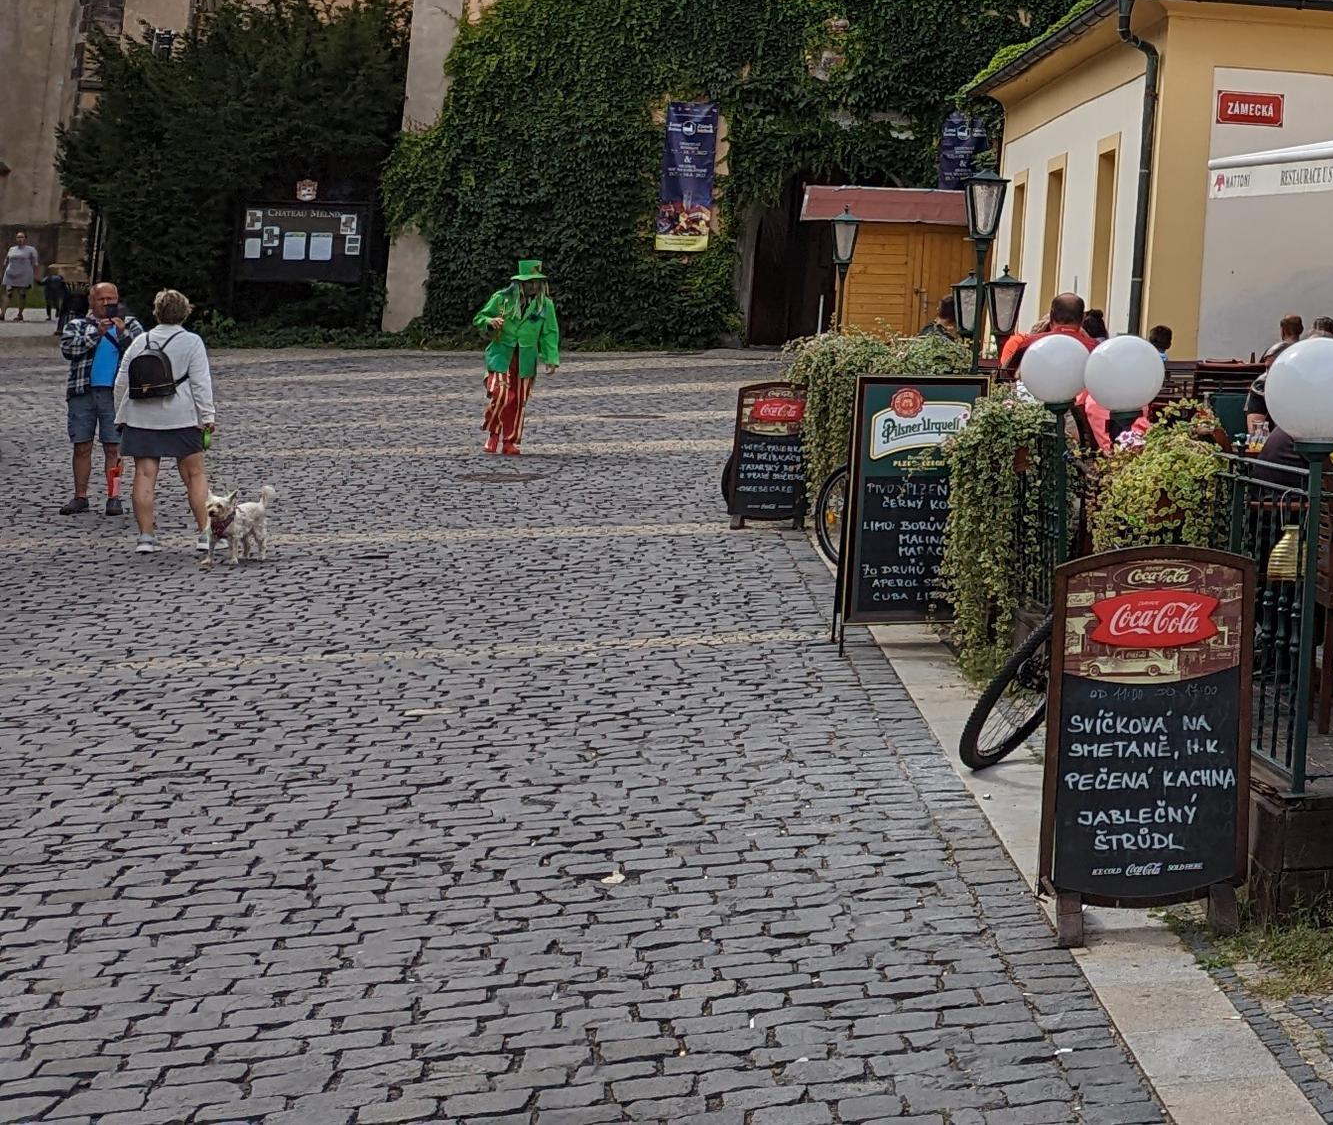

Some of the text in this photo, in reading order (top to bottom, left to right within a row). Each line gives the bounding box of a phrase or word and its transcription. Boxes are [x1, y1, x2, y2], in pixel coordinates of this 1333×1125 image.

[1227, 100, 1274, 118] ZÁMECKÁ
[1226, 174, 1250, 189] MATTONI
[1280, 167, 1322, 187] RESTAURACE
[760, 402, 798, 417] Coca-Cola
[881, 416, 960, 445] Pilsner Urquell
[882, 495, 924, 509] ČERNÝ
[871, 579, 919, 588] APEROL
[1127, 566, 1193, 585] Coca-Cola
[872, 592, 909, 601] CUBA
[1109, 601, 1202, 636] Coca-Cola
[1067, 709, 1212, 735] SVÍČKOVÁ NA
[1064, 766, 1236, 791] PEČENÁ KACHNA
[1077, 793, 1197, 825] JABLEČNÝ
[1094, 828, 1185, 851] ŠTRŮDL
[1104, 867, 1122, 875] COLD
[1125, 862, 1163, 877] Coca-Cola
